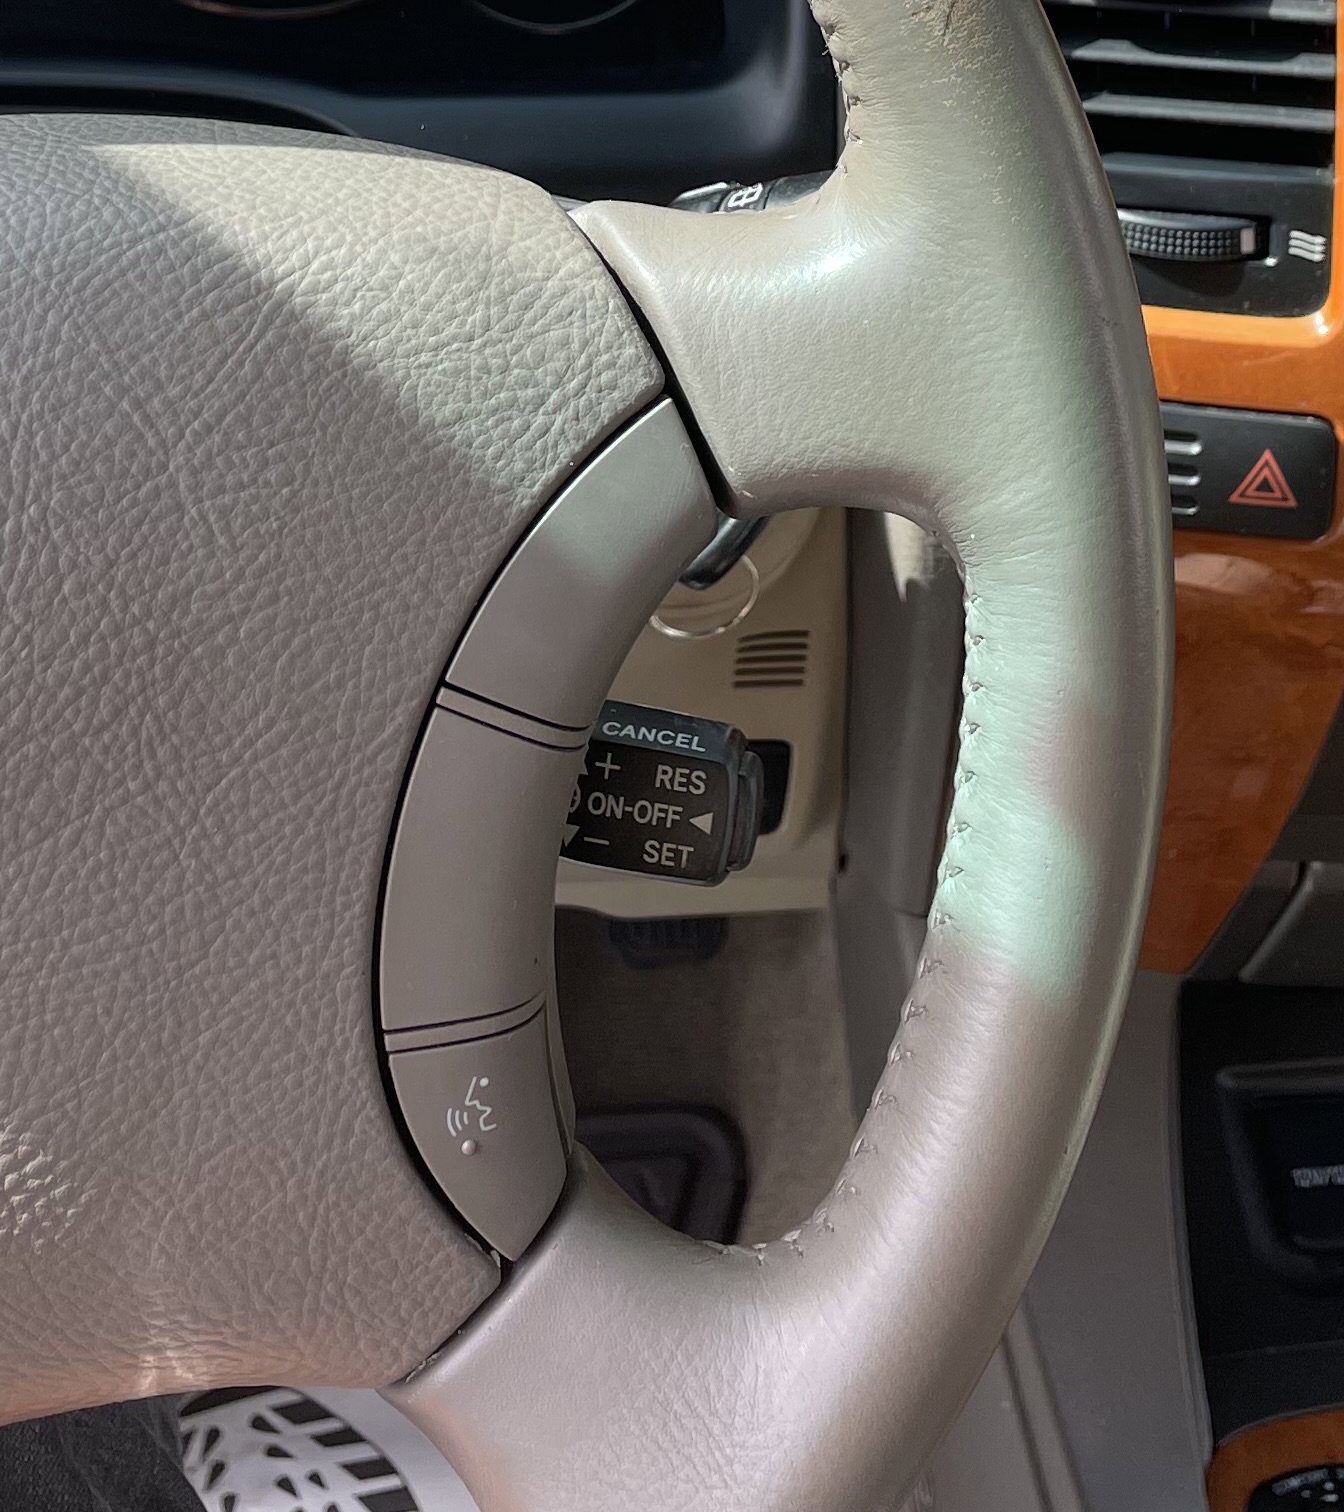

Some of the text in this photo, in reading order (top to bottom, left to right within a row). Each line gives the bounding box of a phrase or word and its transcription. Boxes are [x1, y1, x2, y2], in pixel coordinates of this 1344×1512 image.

[601, 721, 707, 753] CANCEL
[655, 763, 708, 796] RES
[586, 791, 684, 829] ON-OFF
[642, 839, 695, 870] SET
